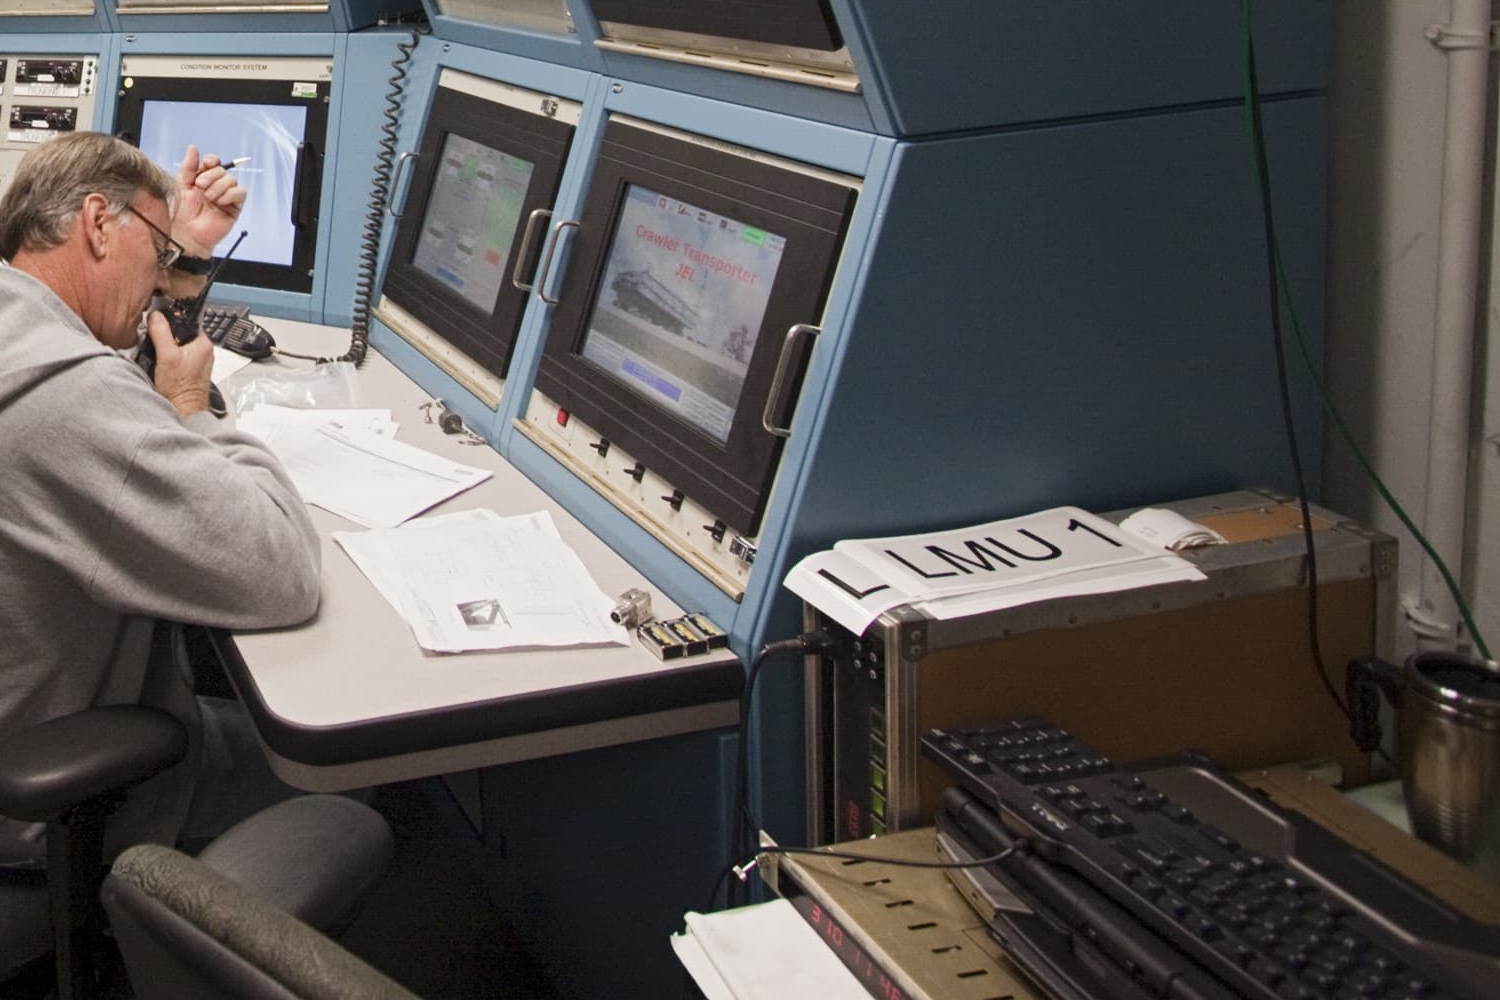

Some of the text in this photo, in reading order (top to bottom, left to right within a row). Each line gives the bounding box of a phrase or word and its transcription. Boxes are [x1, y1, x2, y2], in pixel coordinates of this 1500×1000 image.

[180, 63, 212, 71] CONDITION
[214, 63, 241, 71] MONITOR
[635, 224, 757, 284] Crawler Transporter
[676, 263, 696, 282] JEL
[884, 519, 1124, 579] LMU 1
